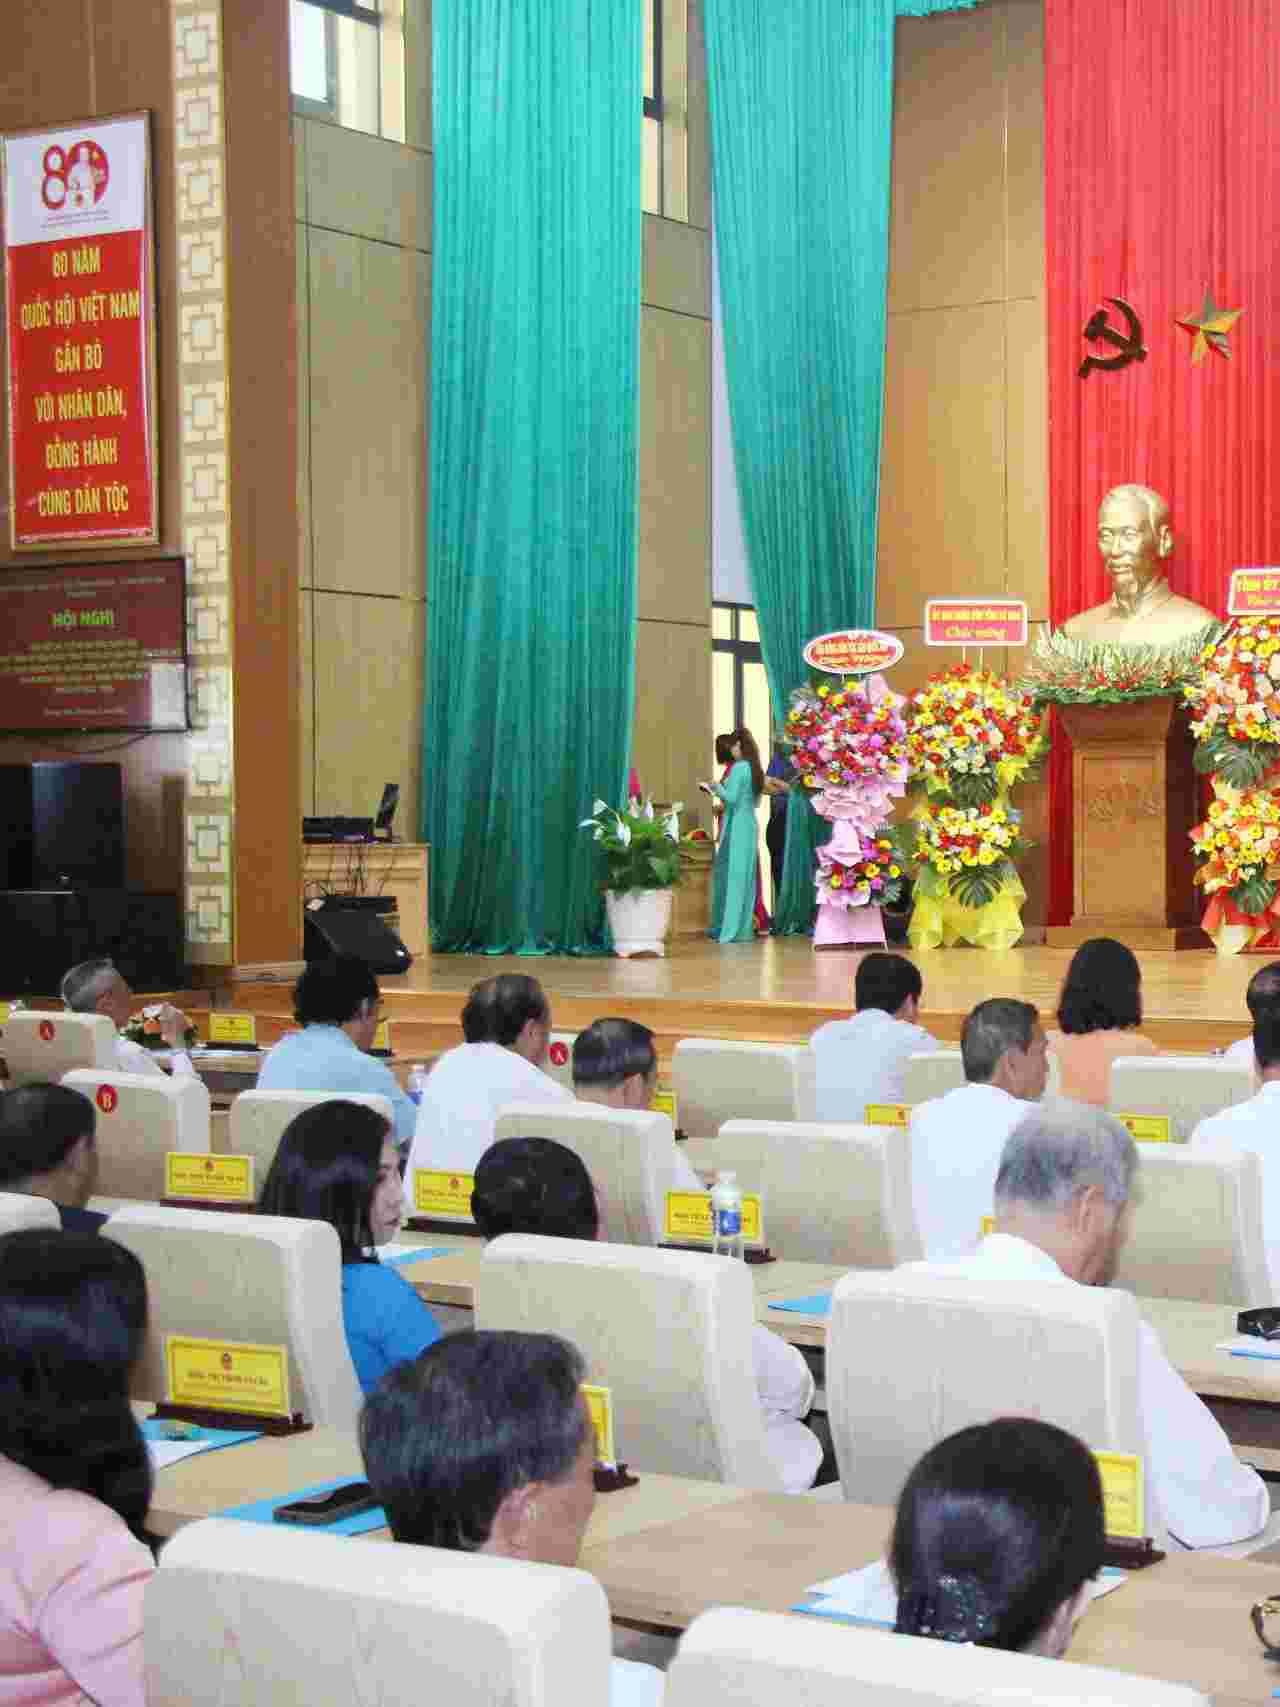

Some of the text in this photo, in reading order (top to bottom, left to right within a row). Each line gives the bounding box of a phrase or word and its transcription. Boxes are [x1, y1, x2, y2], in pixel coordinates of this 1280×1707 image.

[53, 251, 68, 277] 80
[55, 292, 76, 328] HỘI
[80, 290, 107, 325] VIỆT
[110, 290, 140, 319] NAM
[58, 388, 93, 420] NHÂN
[83, 434, 118, 465] HÀNH
[104, 481, 129, 519] TỘC
